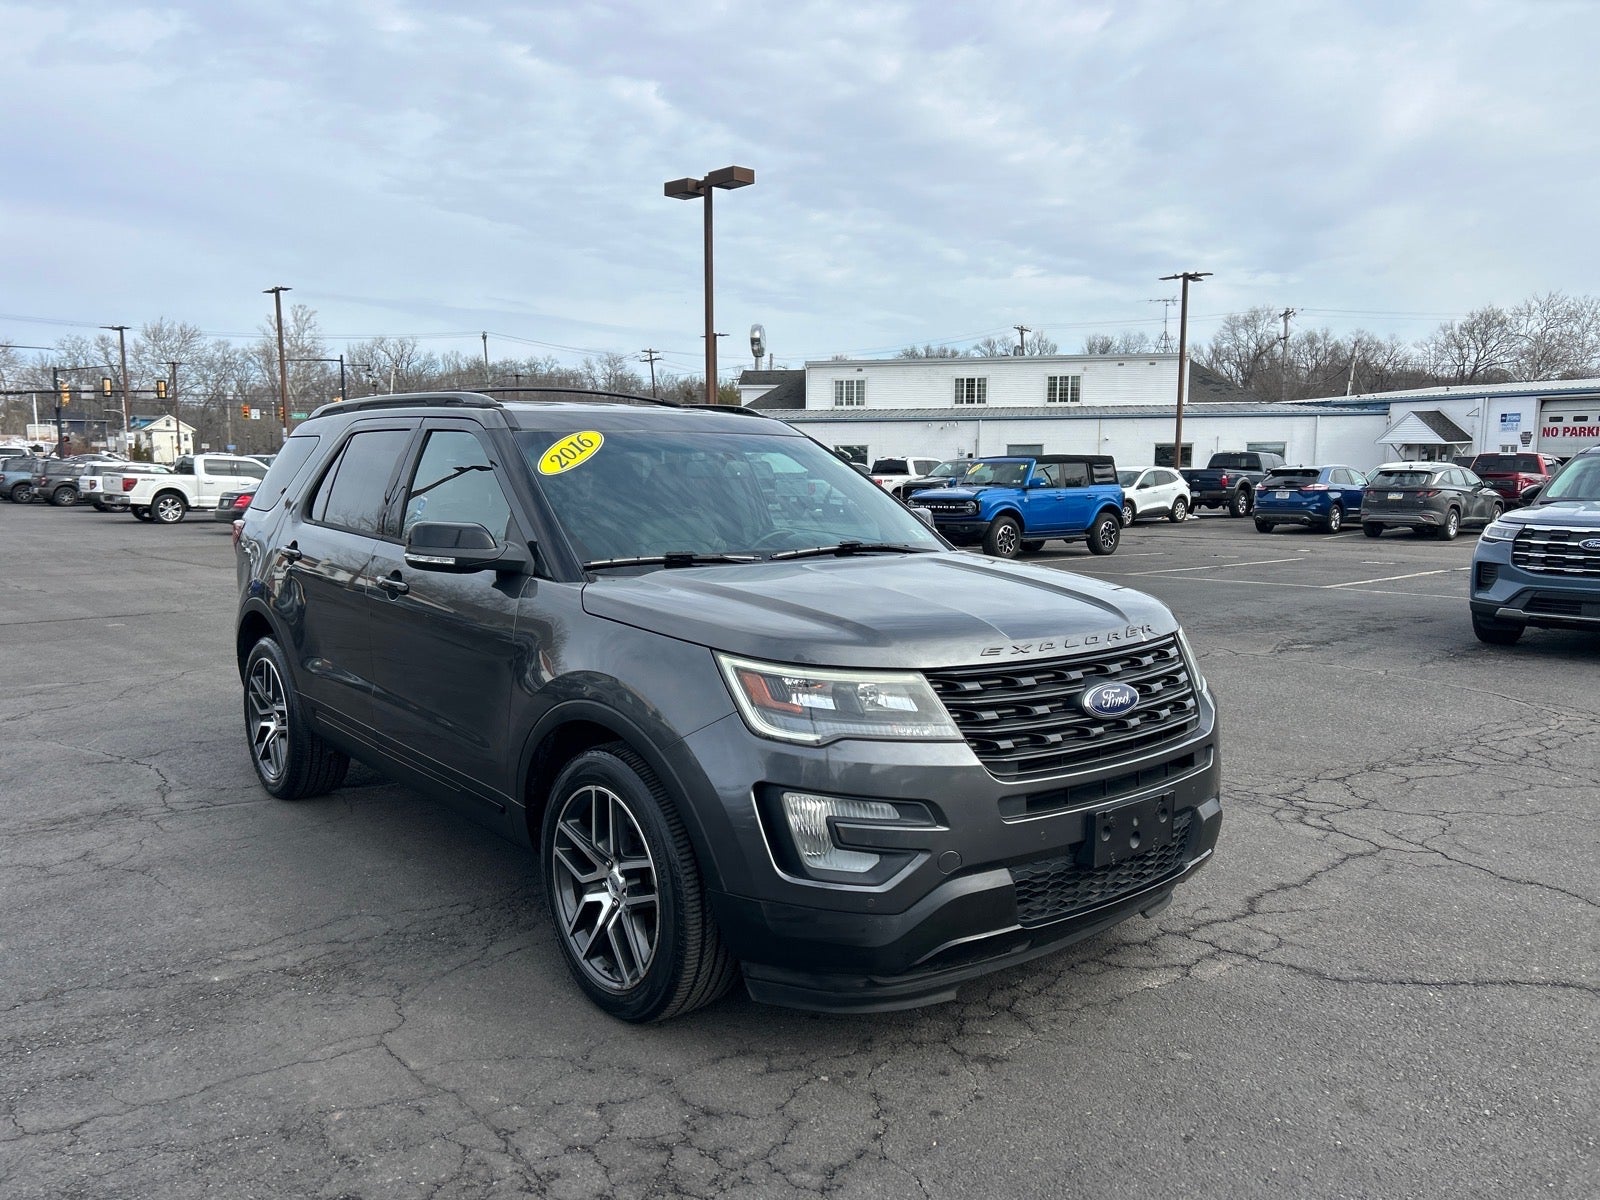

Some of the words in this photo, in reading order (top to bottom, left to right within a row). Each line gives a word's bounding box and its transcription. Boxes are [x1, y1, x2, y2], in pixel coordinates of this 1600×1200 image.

[1542, 427, 1559, 437] NO
[549, 434, 594, 469] 2016
[980, 624, 1153, 657] EXPLORER
[1101, 688, 1131, 709] Ford
